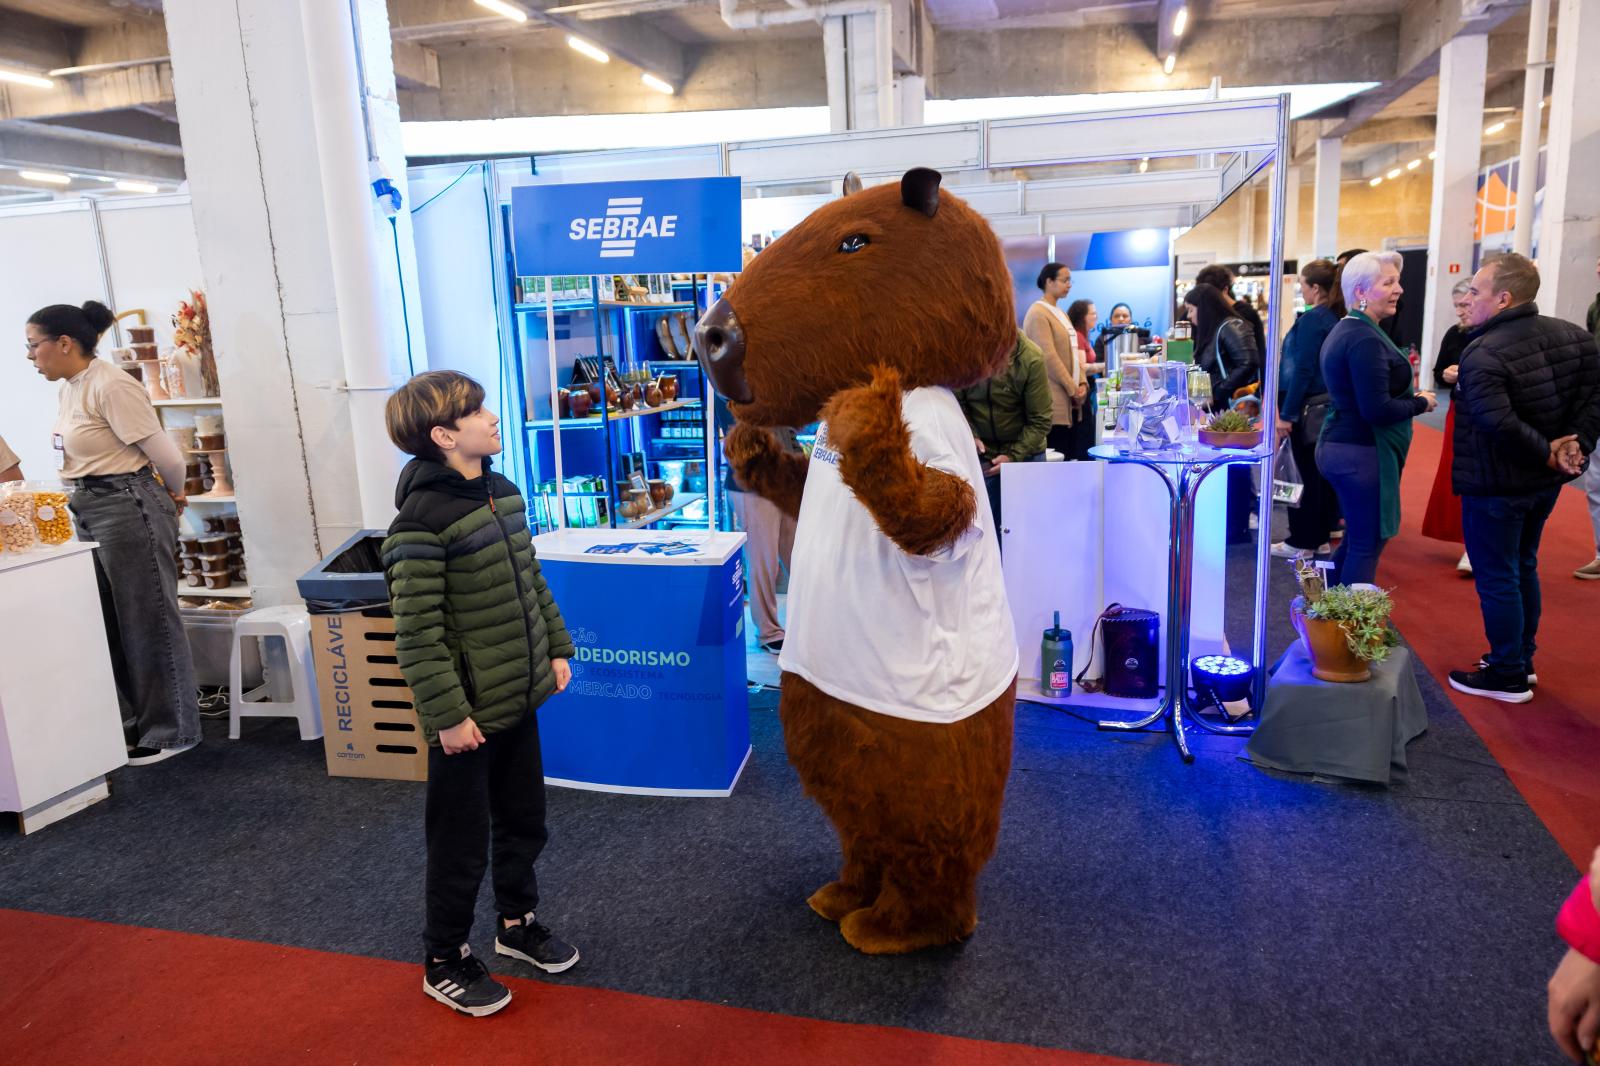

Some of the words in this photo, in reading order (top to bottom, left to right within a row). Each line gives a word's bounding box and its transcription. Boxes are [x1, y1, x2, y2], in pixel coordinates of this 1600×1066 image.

[569, 215, 678, 240] SEBRAE
[590, 667, 665, 680] ECOSSISTEMA
[569, 681, 652, 700] MERCADO
[660, 691, 723, 702] TECNOLOGIA
